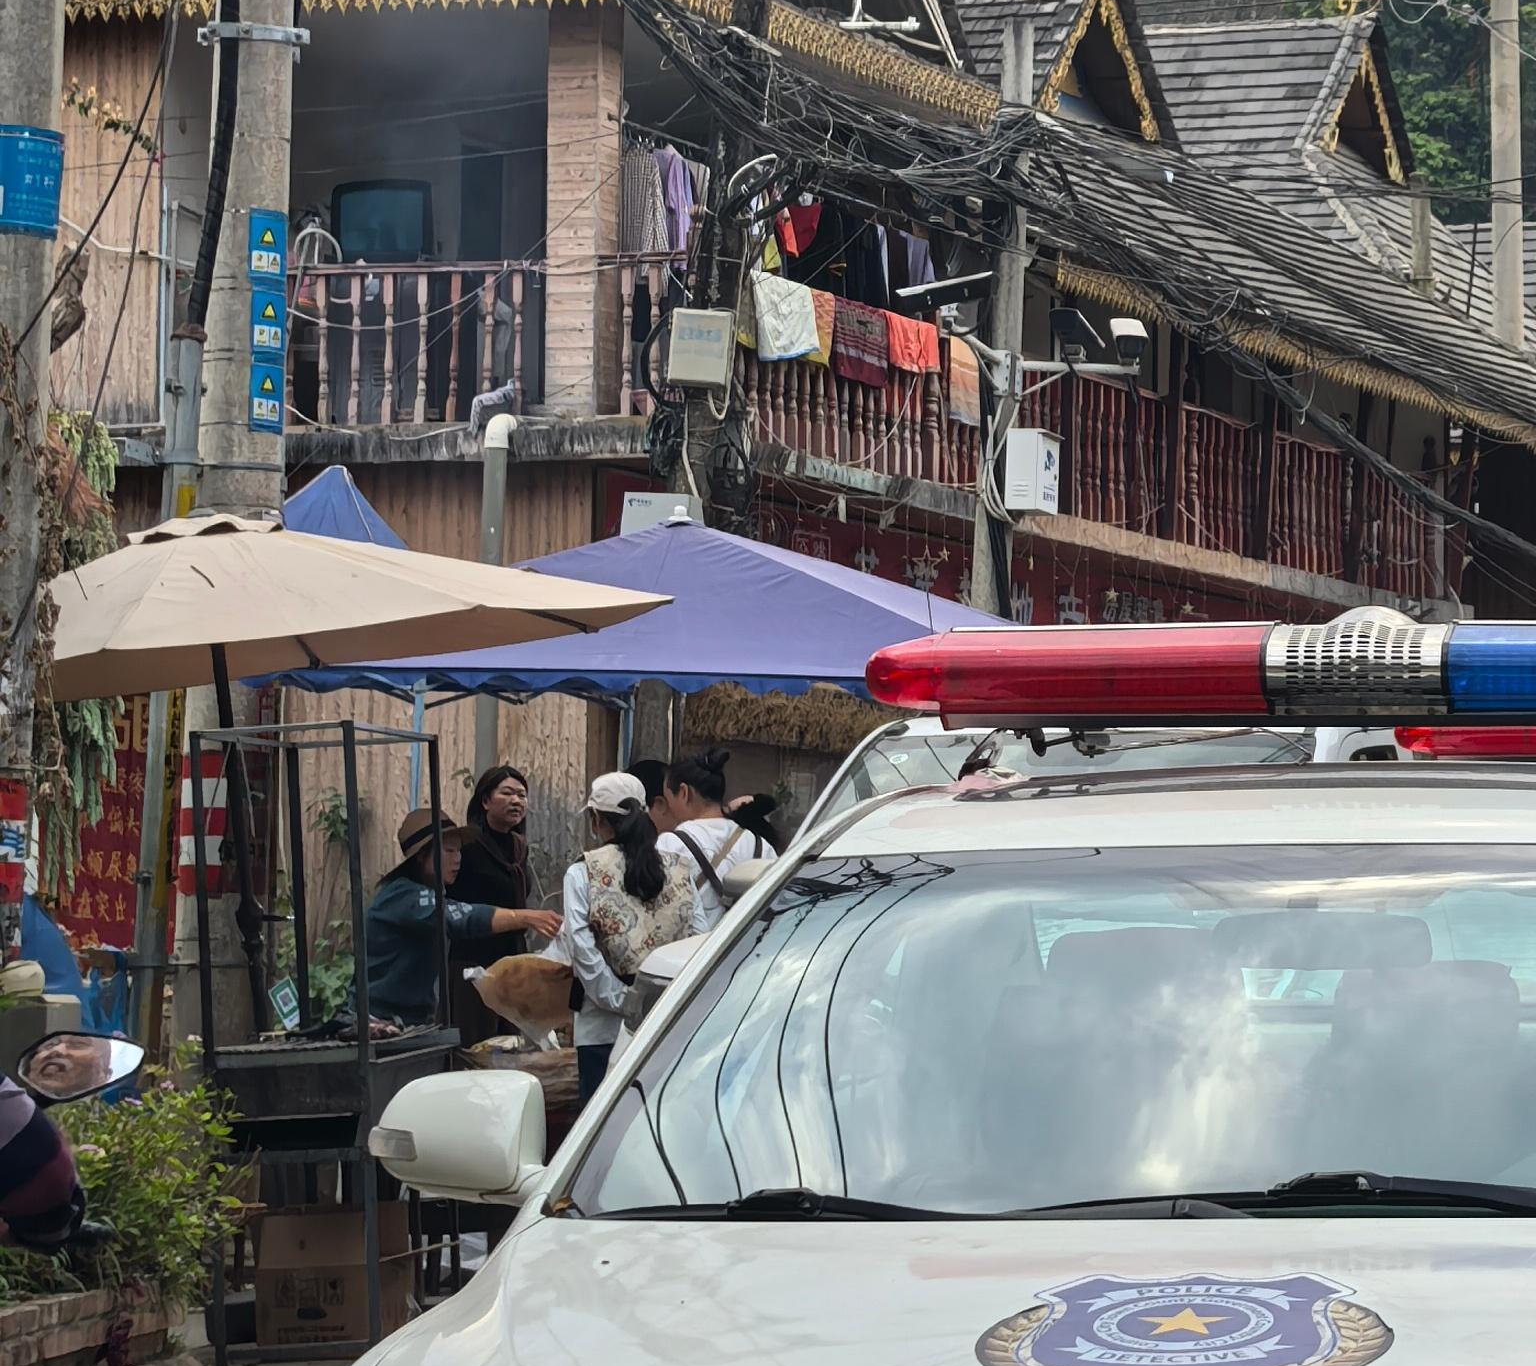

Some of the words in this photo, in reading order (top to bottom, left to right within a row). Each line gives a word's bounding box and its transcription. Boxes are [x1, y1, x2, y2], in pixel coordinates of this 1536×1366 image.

[1136, 1287, 1254, 1296] POLICE
[1134, 1298, 1197, 1307] County
[1096, 1352, 1249, 1363] DETECTIVE
